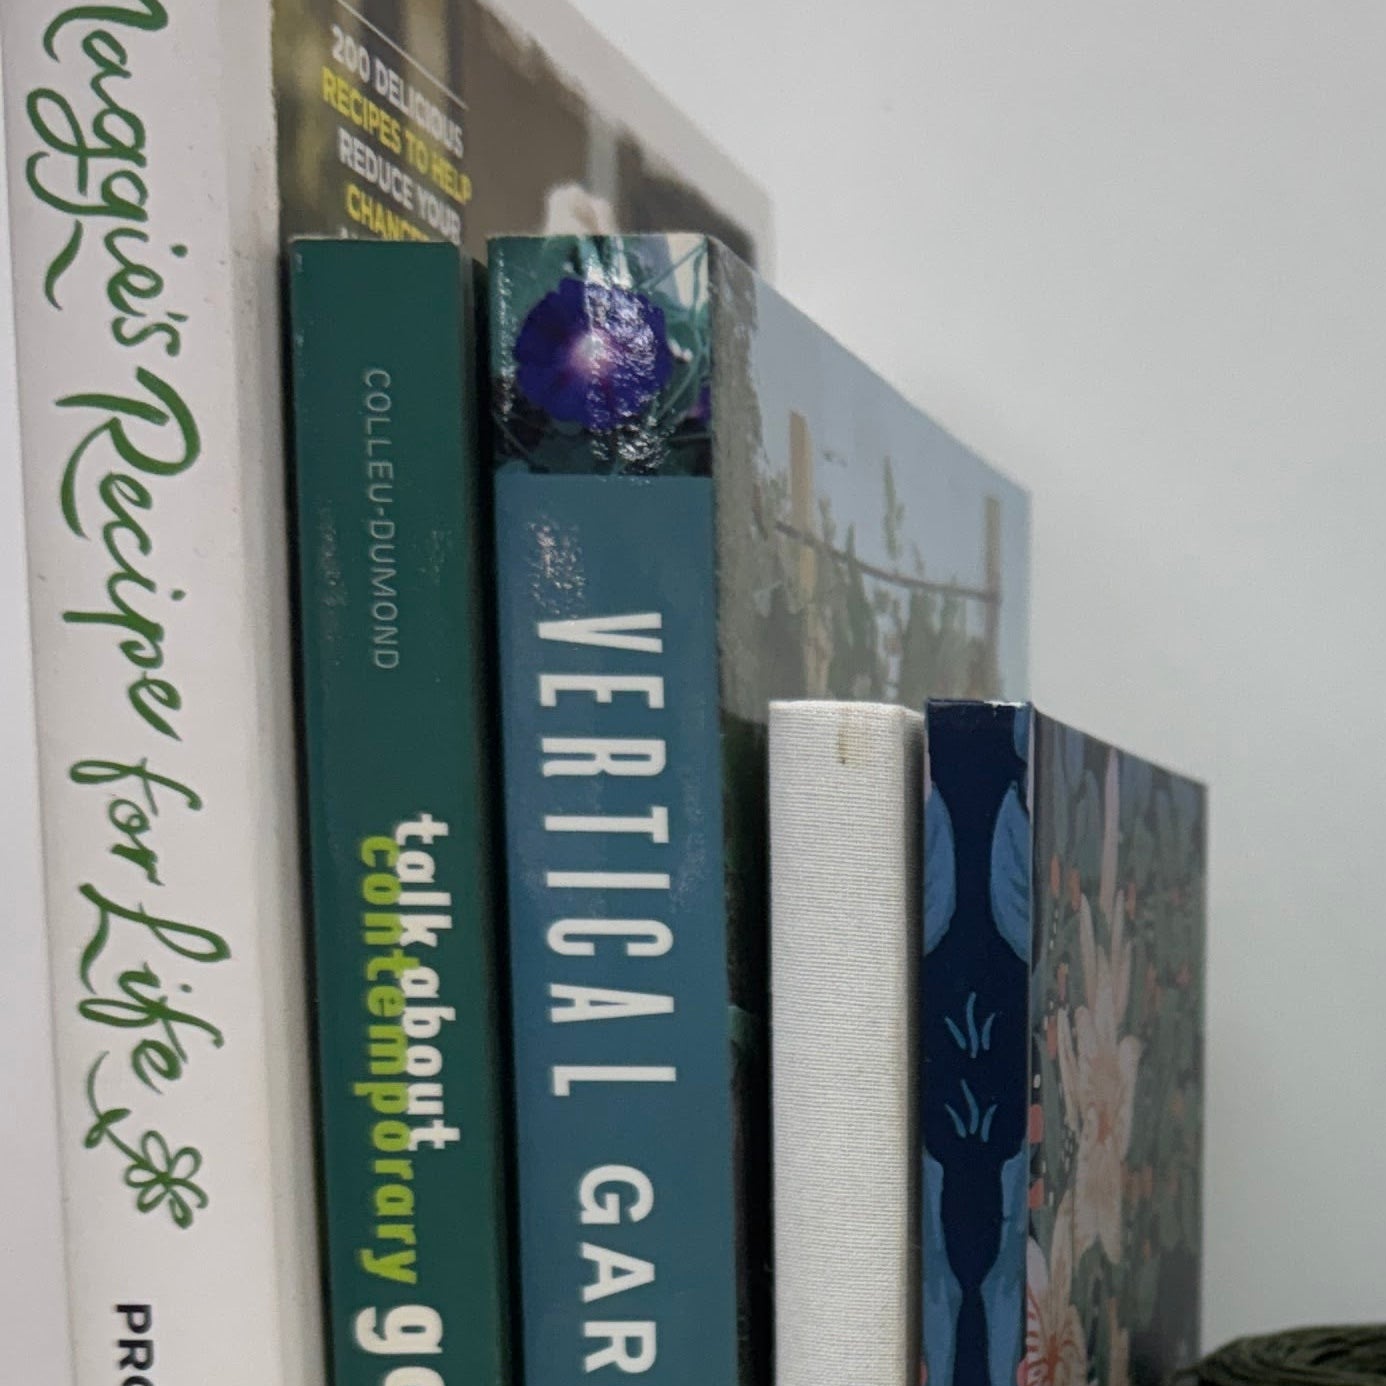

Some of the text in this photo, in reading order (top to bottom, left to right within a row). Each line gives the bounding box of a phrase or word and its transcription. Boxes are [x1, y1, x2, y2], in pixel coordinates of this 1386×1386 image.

[321, 65, 473, 206] RECIPES TO HELP
[330, 24, 465, 159] 200 DELICIOUS
[337, 126, 462, 247] REDUCE YOUR
[56, 367, 201, 741] Recipe
[365, 368, 400, 670] COLLEU-DUMOND
[69, 758, 202, 887] for
[536, 611, 678, 1097] VERTICAL
[78, 883, 232, 1094] Life
[353, 835, 419, 1285] contemporary
[393, 812, 461, 1152] talk about
